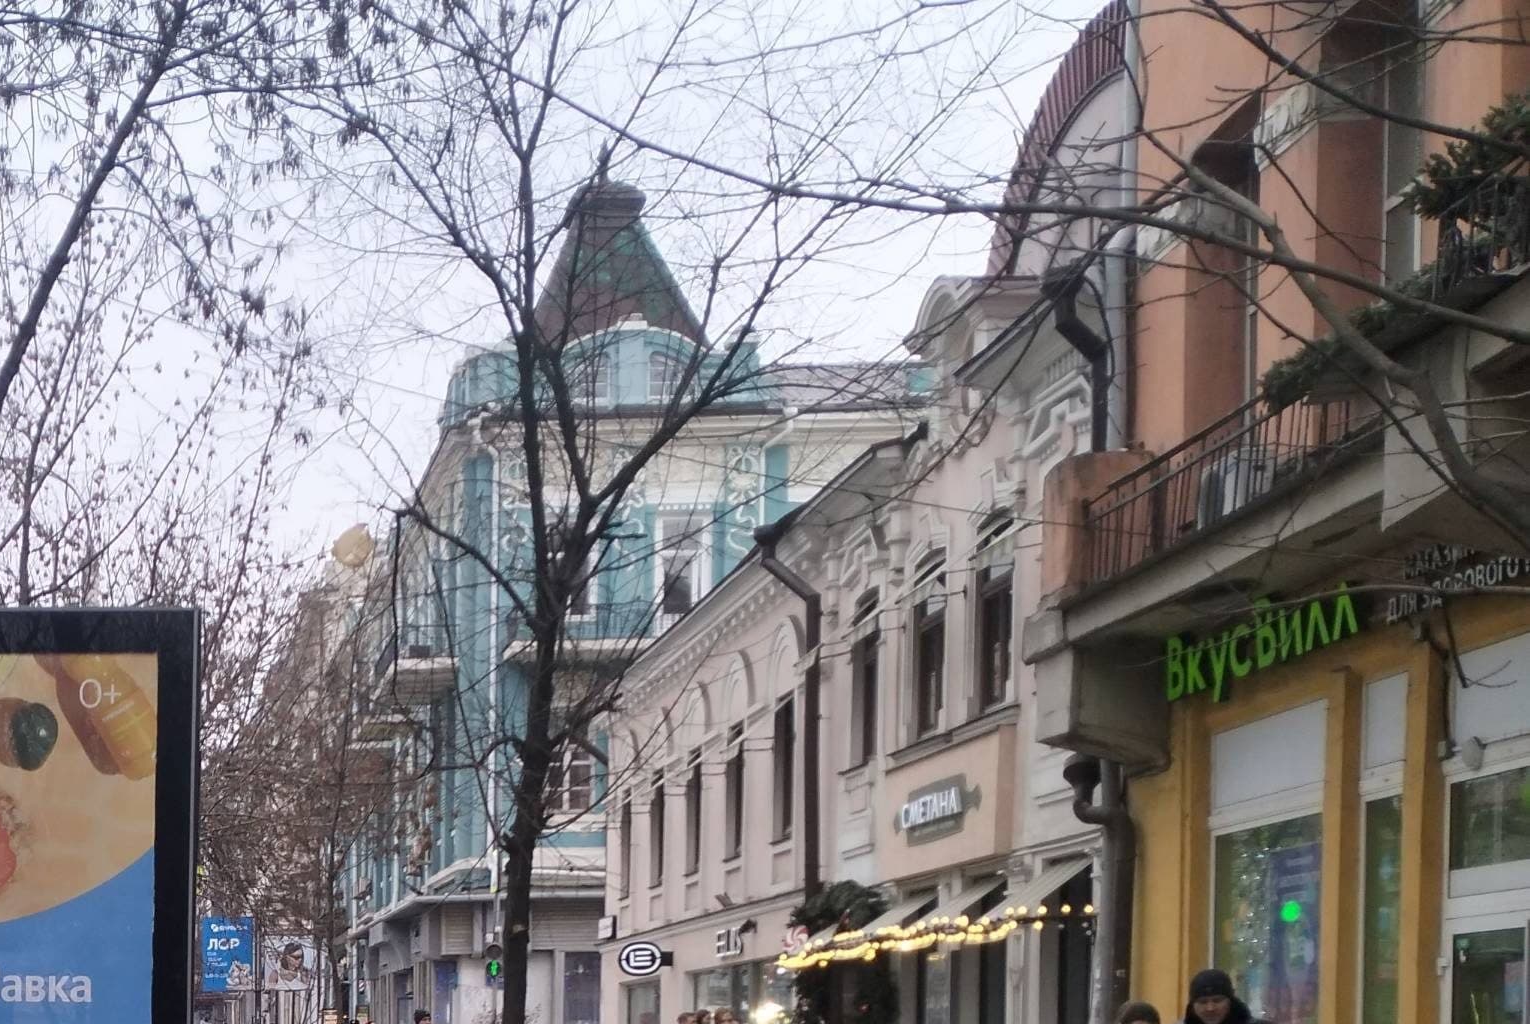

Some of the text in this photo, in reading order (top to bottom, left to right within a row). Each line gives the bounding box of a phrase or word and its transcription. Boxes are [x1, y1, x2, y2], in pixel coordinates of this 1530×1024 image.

[1167, 582, 1358, 703] ВкусВилл
[79, 678, 122, 709] 0+
[901, 787, 963, 829] СМЕТАНА
